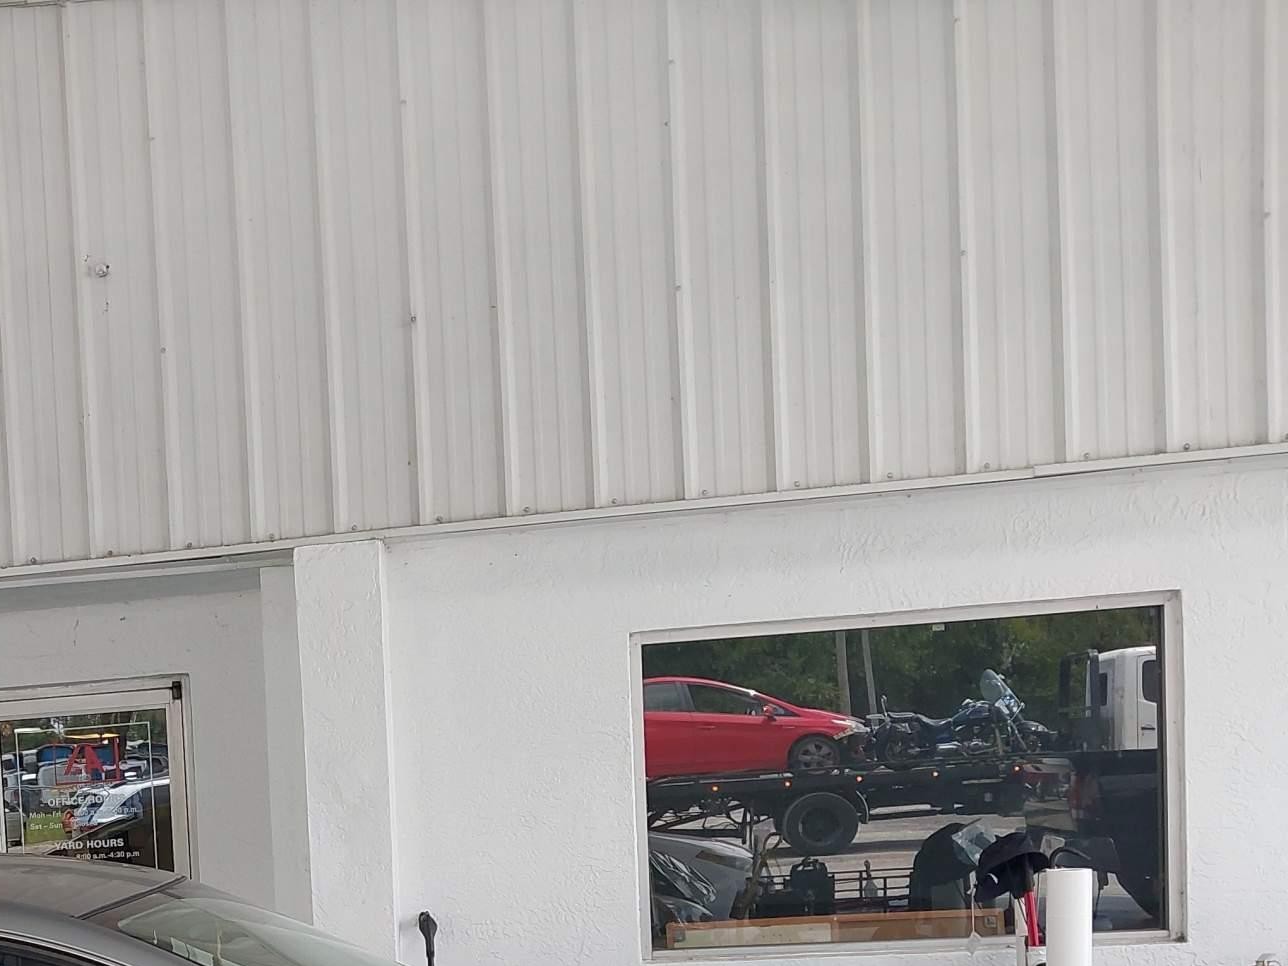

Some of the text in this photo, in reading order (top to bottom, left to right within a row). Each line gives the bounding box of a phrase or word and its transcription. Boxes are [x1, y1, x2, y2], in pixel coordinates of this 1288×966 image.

[47, 796, 84, 807] OFFICE
[54, 838, 125, 850] YARD HOURS
